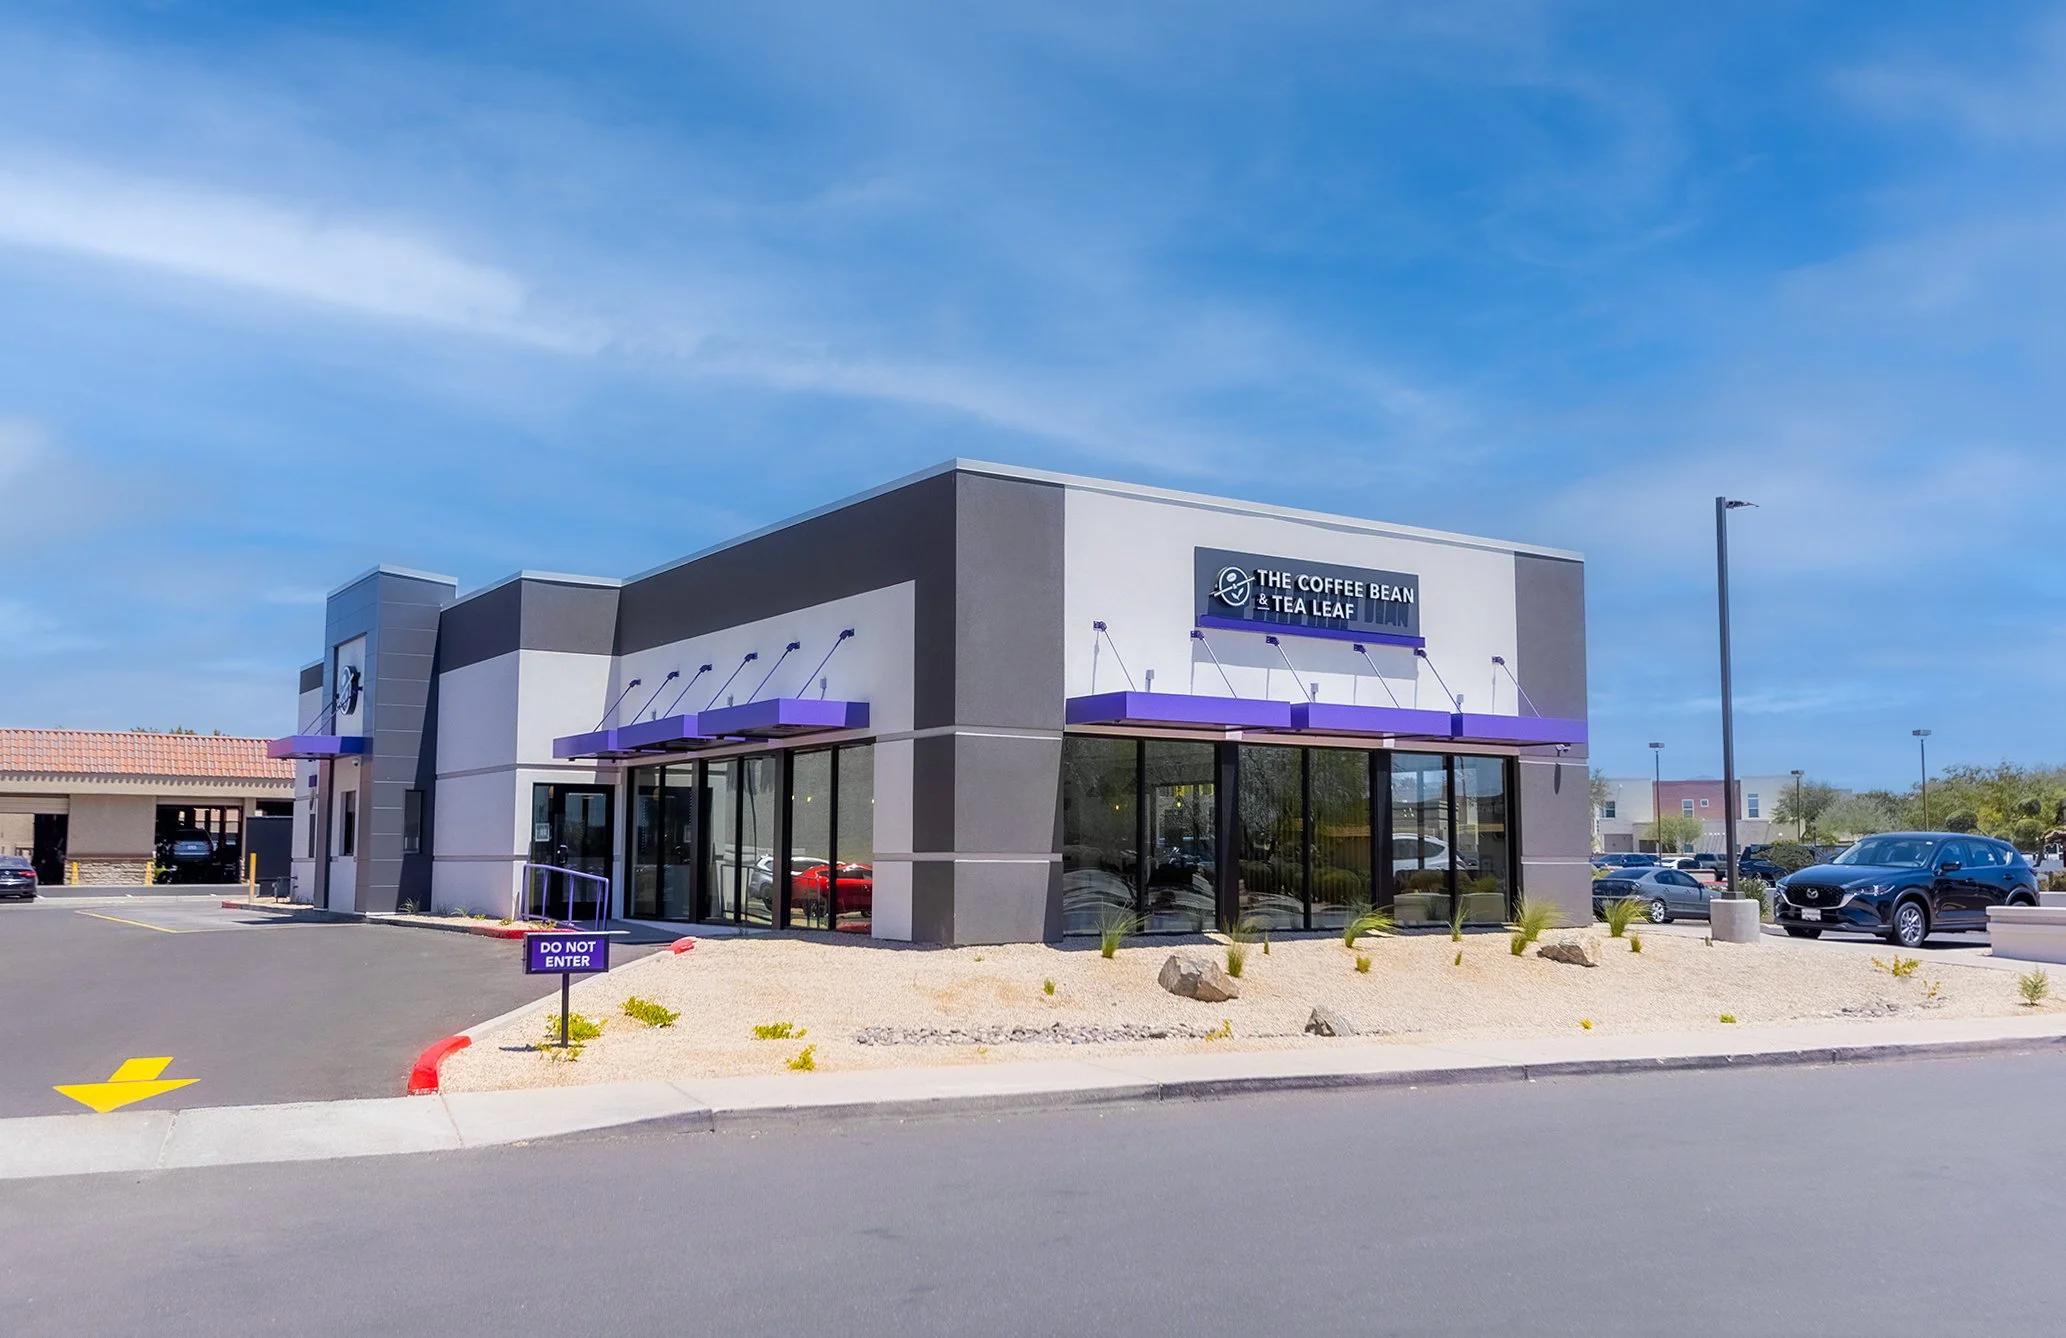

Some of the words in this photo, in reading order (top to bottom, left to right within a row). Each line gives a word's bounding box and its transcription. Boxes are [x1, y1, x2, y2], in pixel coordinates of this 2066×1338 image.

[1257, 569, 1291, 589] THE
[1298, 574, 1364, 598] COFFEE
[1370, 583, 1414, 603] BEAN
[1258, 593, 1268, 606] &
[1272, 595, 1306, 615] TEA
[1313, 599, 1354, 619] LEAF
[540, 942, 562, 953] DO
[566, 941, 596, 953] NOT
[545, 955, 590, 967] ENTER
